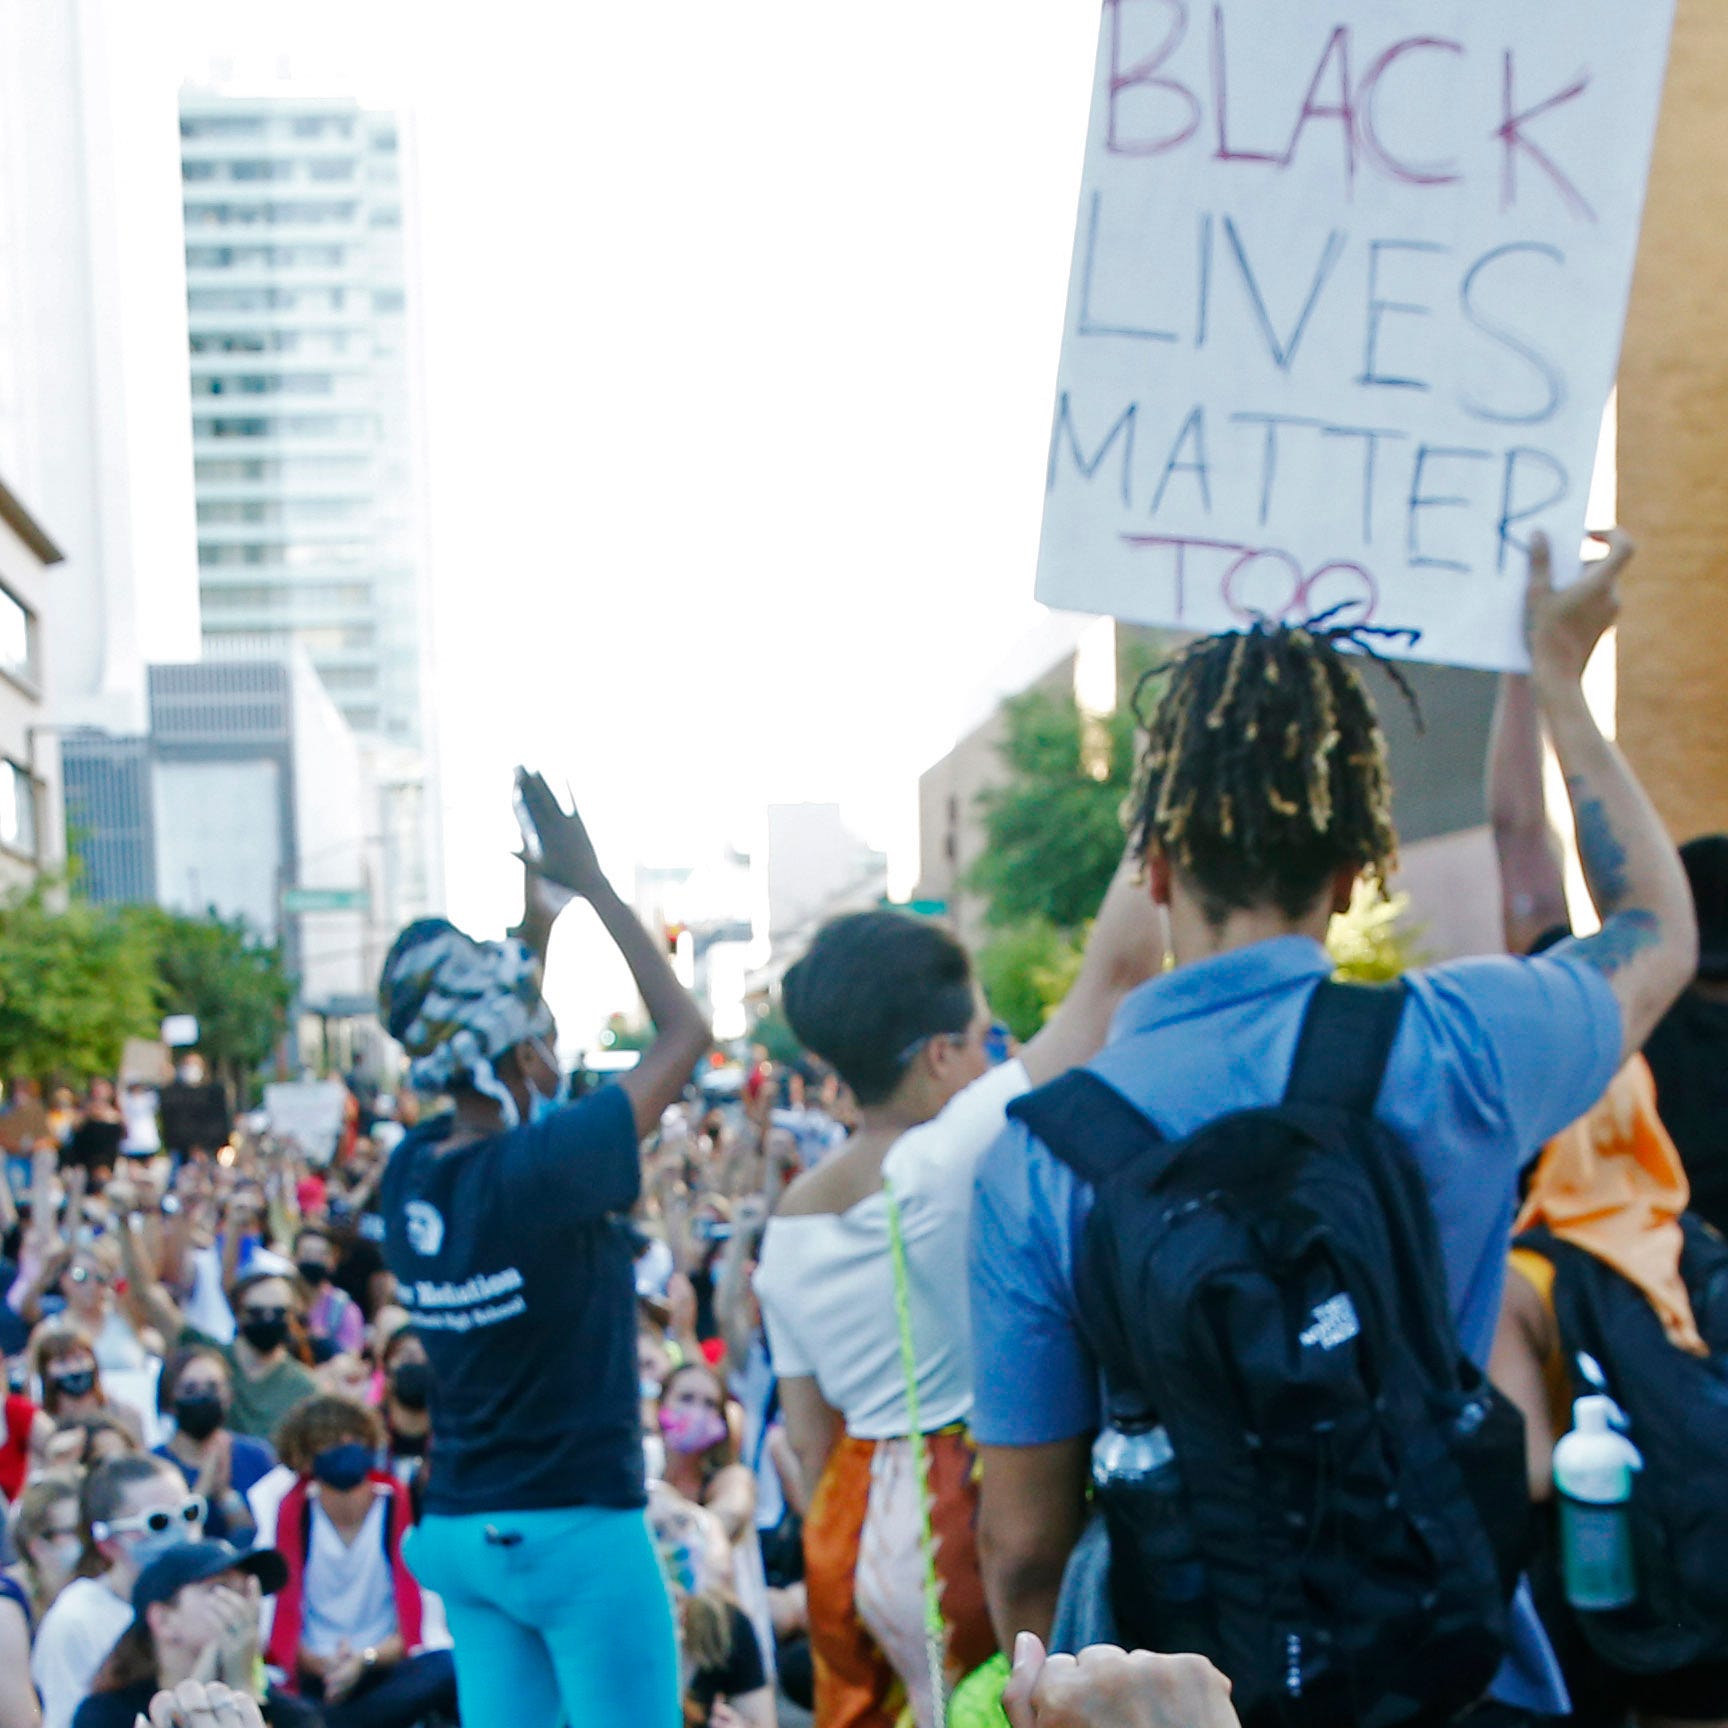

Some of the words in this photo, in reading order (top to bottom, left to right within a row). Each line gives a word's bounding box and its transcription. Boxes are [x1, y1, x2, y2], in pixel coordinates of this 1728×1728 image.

[1102, 0, 1599, 222] BLACK
[1075, 190, 1566, 427] LIVES
[1046, 391, 1569, 574] MATTER
[1119, 535, 1380, 628] TOO
